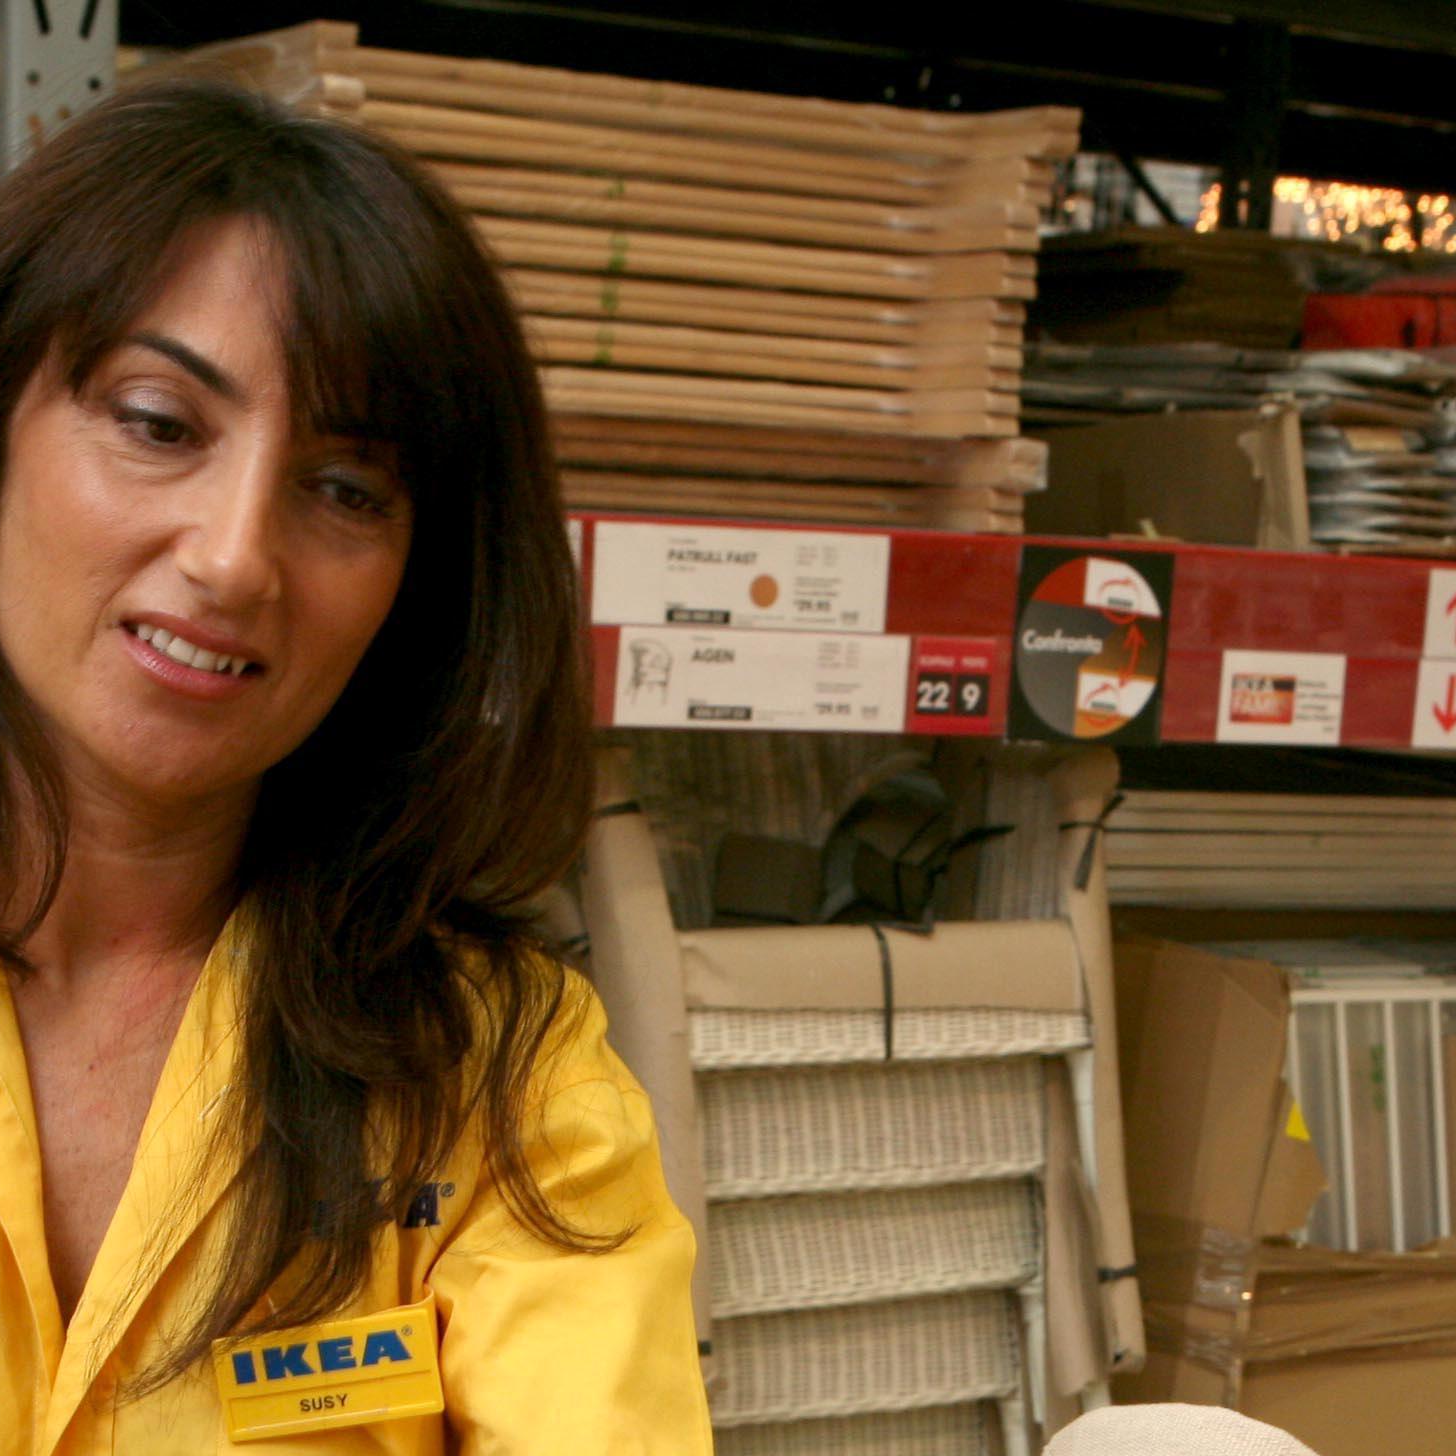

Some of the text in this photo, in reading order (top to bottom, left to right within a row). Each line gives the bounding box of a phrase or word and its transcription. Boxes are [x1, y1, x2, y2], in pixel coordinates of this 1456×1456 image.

[666, 549, 758, 566] PATRULL FAST
[1021, 628, 1103, 655] Confronta
[691, 648, 735, 664] AGEN
[916, 680, 981, 712] 22 9
[232, 1329, 412, 1385] IKEA
[299, 1393, 348, 1413] SUSY
